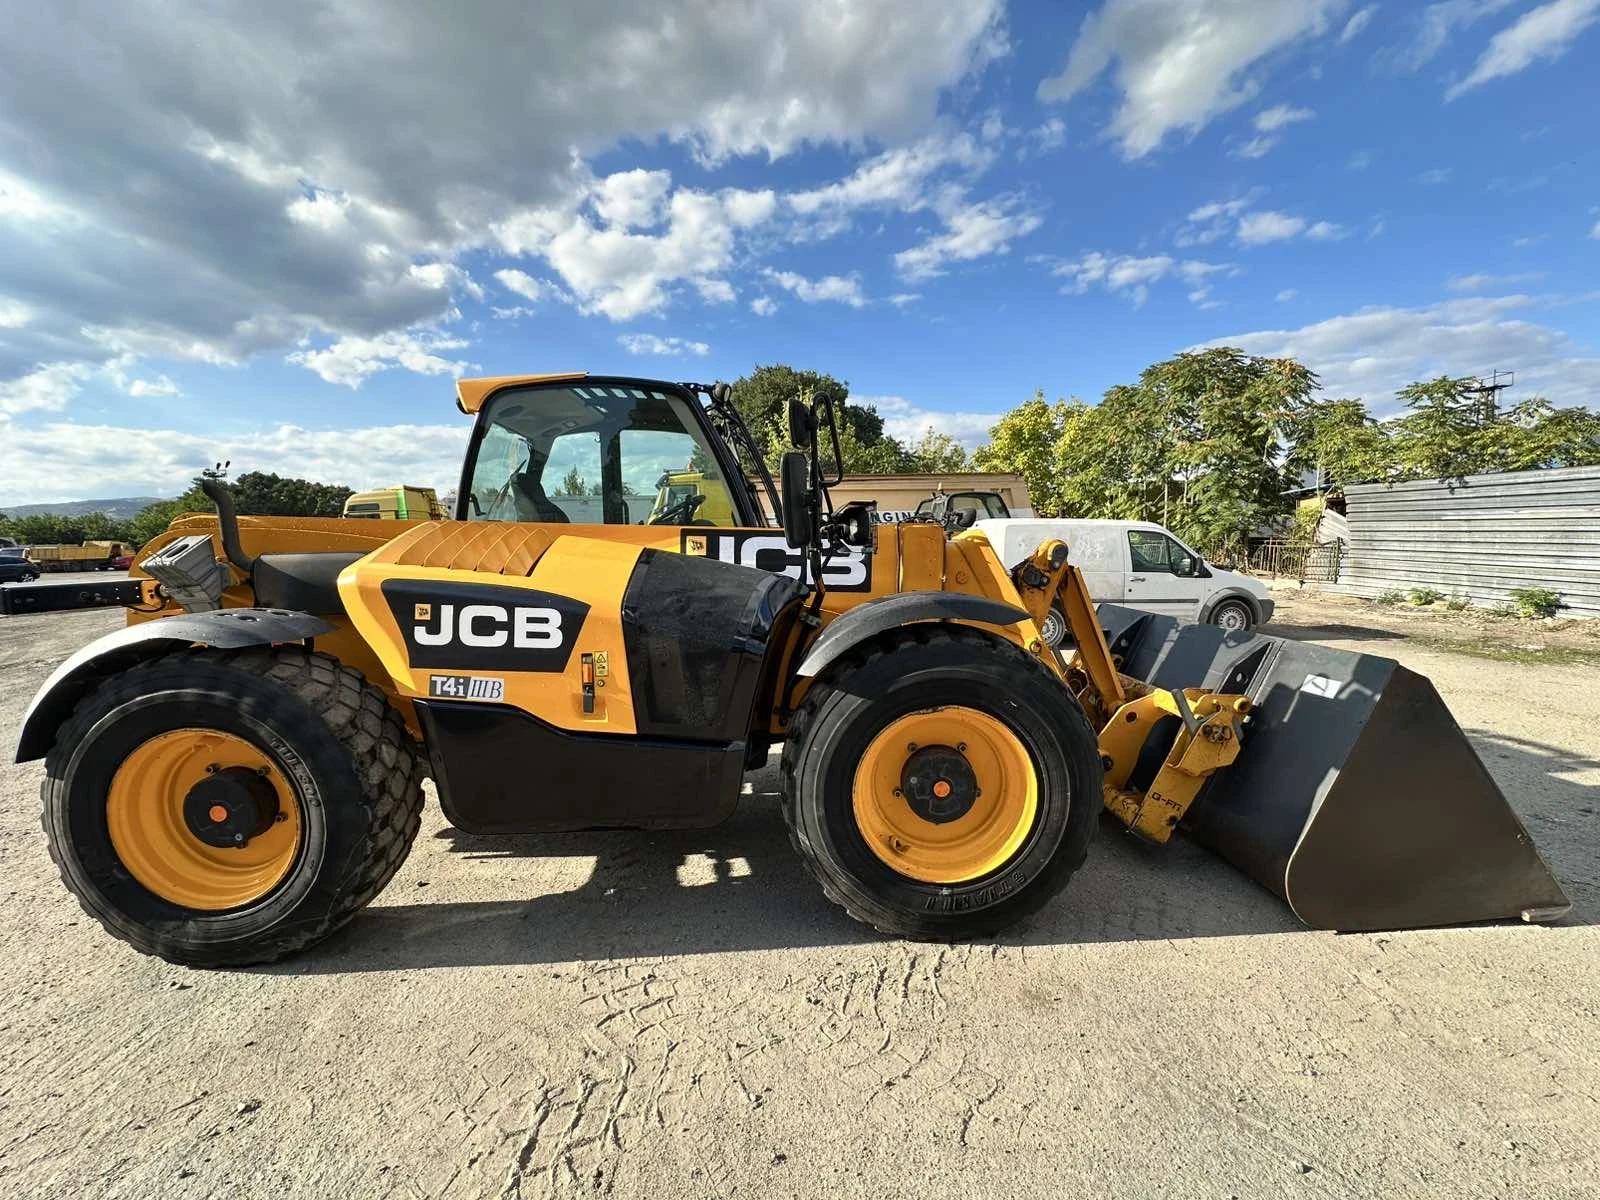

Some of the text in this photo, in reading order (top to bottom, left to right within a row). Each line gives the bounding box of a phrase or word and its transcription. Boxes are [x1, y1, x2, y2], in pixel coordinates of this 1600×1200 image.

[870, 511, 913, 522] NGIN
[414, 604, 563, 649] JCB
[431, 676, 465, 697] T4i
